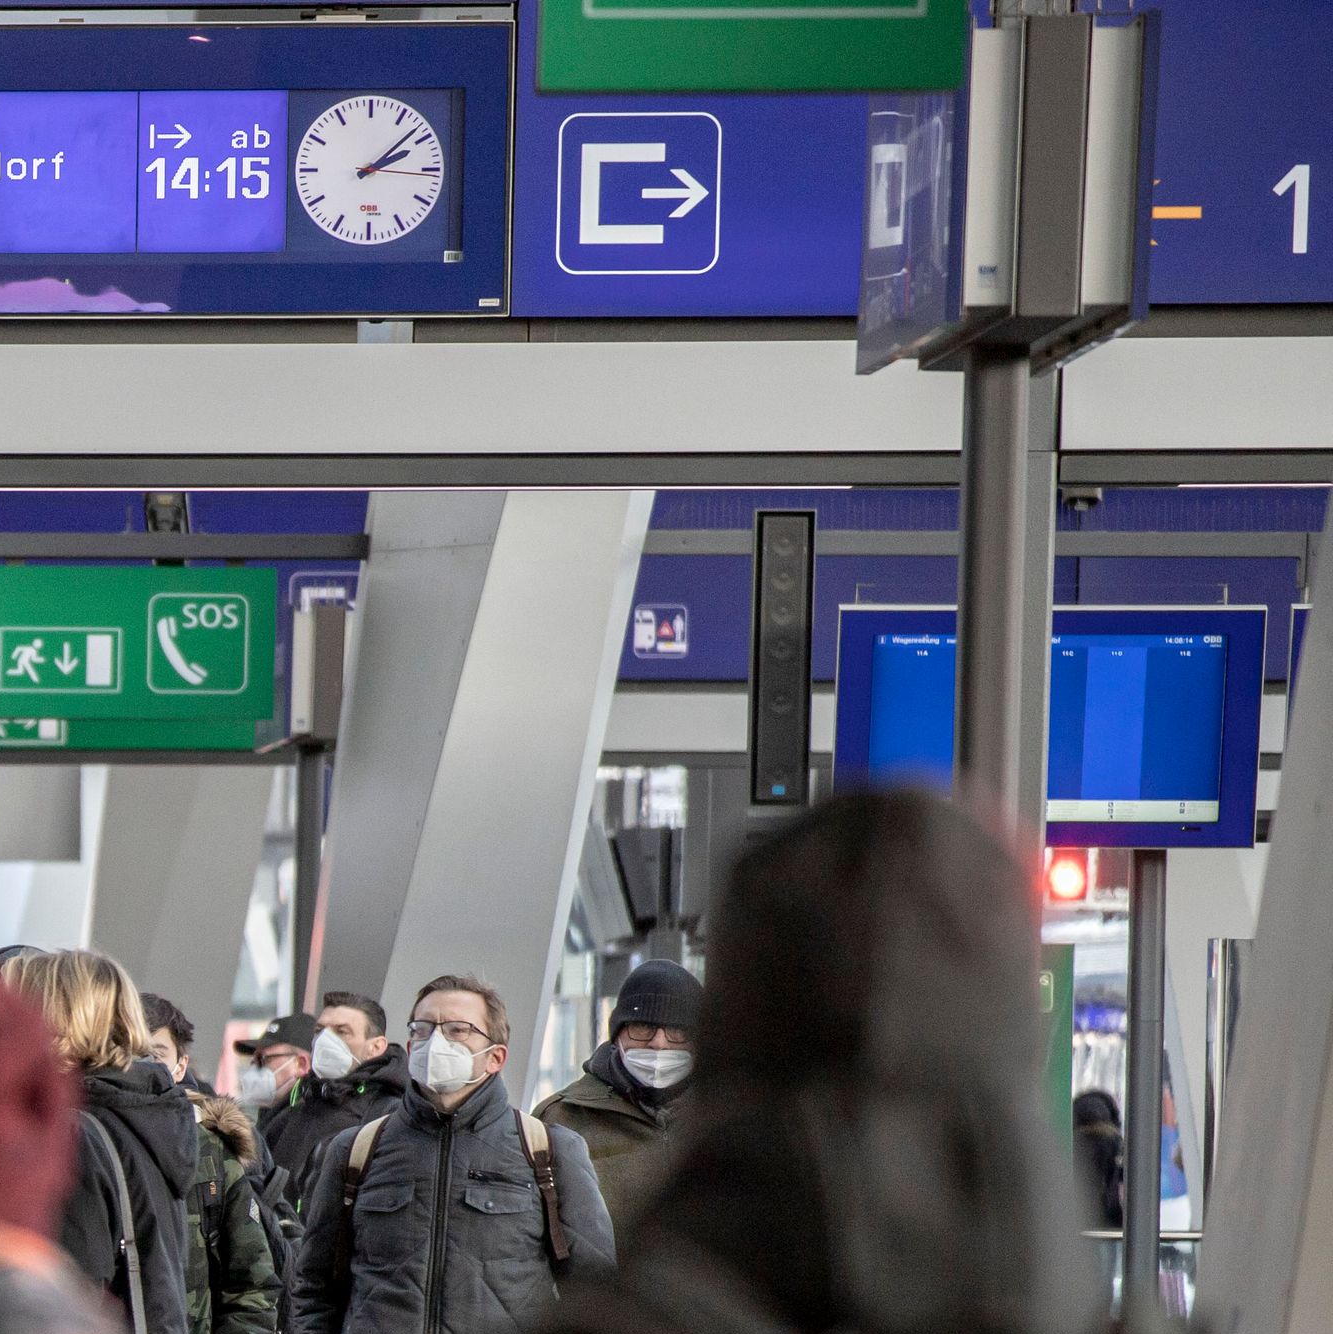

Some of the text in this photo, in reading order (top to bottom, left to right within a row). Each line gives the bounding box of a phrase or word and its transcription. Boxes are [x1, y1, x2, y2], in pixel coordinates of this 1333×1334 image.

[231, 123, 271, 149] ab
[145, 156, 270, 200] 14:15
[181, 603, 239, 629] SOS
